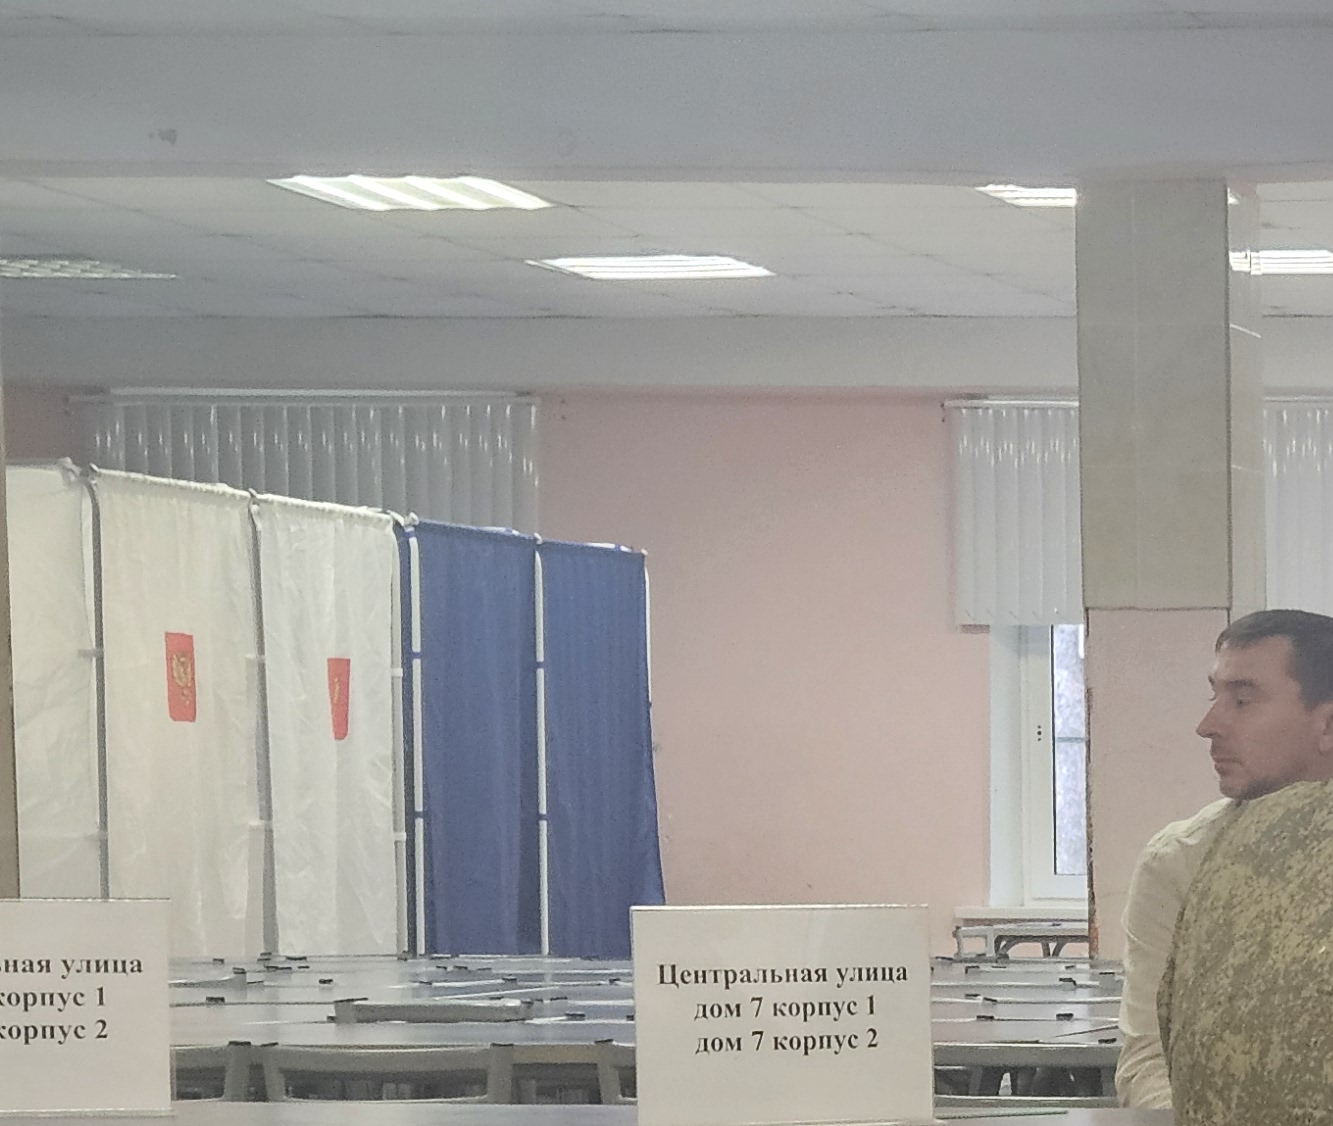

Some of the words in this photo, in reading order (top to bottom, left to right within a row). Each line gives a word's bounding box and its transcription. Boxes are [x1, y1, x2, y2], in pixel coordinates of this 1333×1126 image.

[0, 959, 51, 975] ная
[60, 958, 144, 980] улица
[657, 963, 828, 991] Центральная
[836, 965, 909, 989] улица
[96, 986, 106, 1007] 1
[693, 1003, 742, 1022] дом
[749, 996, 764, 1018] 7
[771, 1000, 858, 1023] корпус
[866, 994, 876, 1016] 1
[95, 1018, 109, 1039] 2
[695, 1035, 743, 1055] дом
[750, 1030, 765, 1052] 7
[772, 1033, 859, 1057] корпус
[866, 1027, 879, 1049] 2
